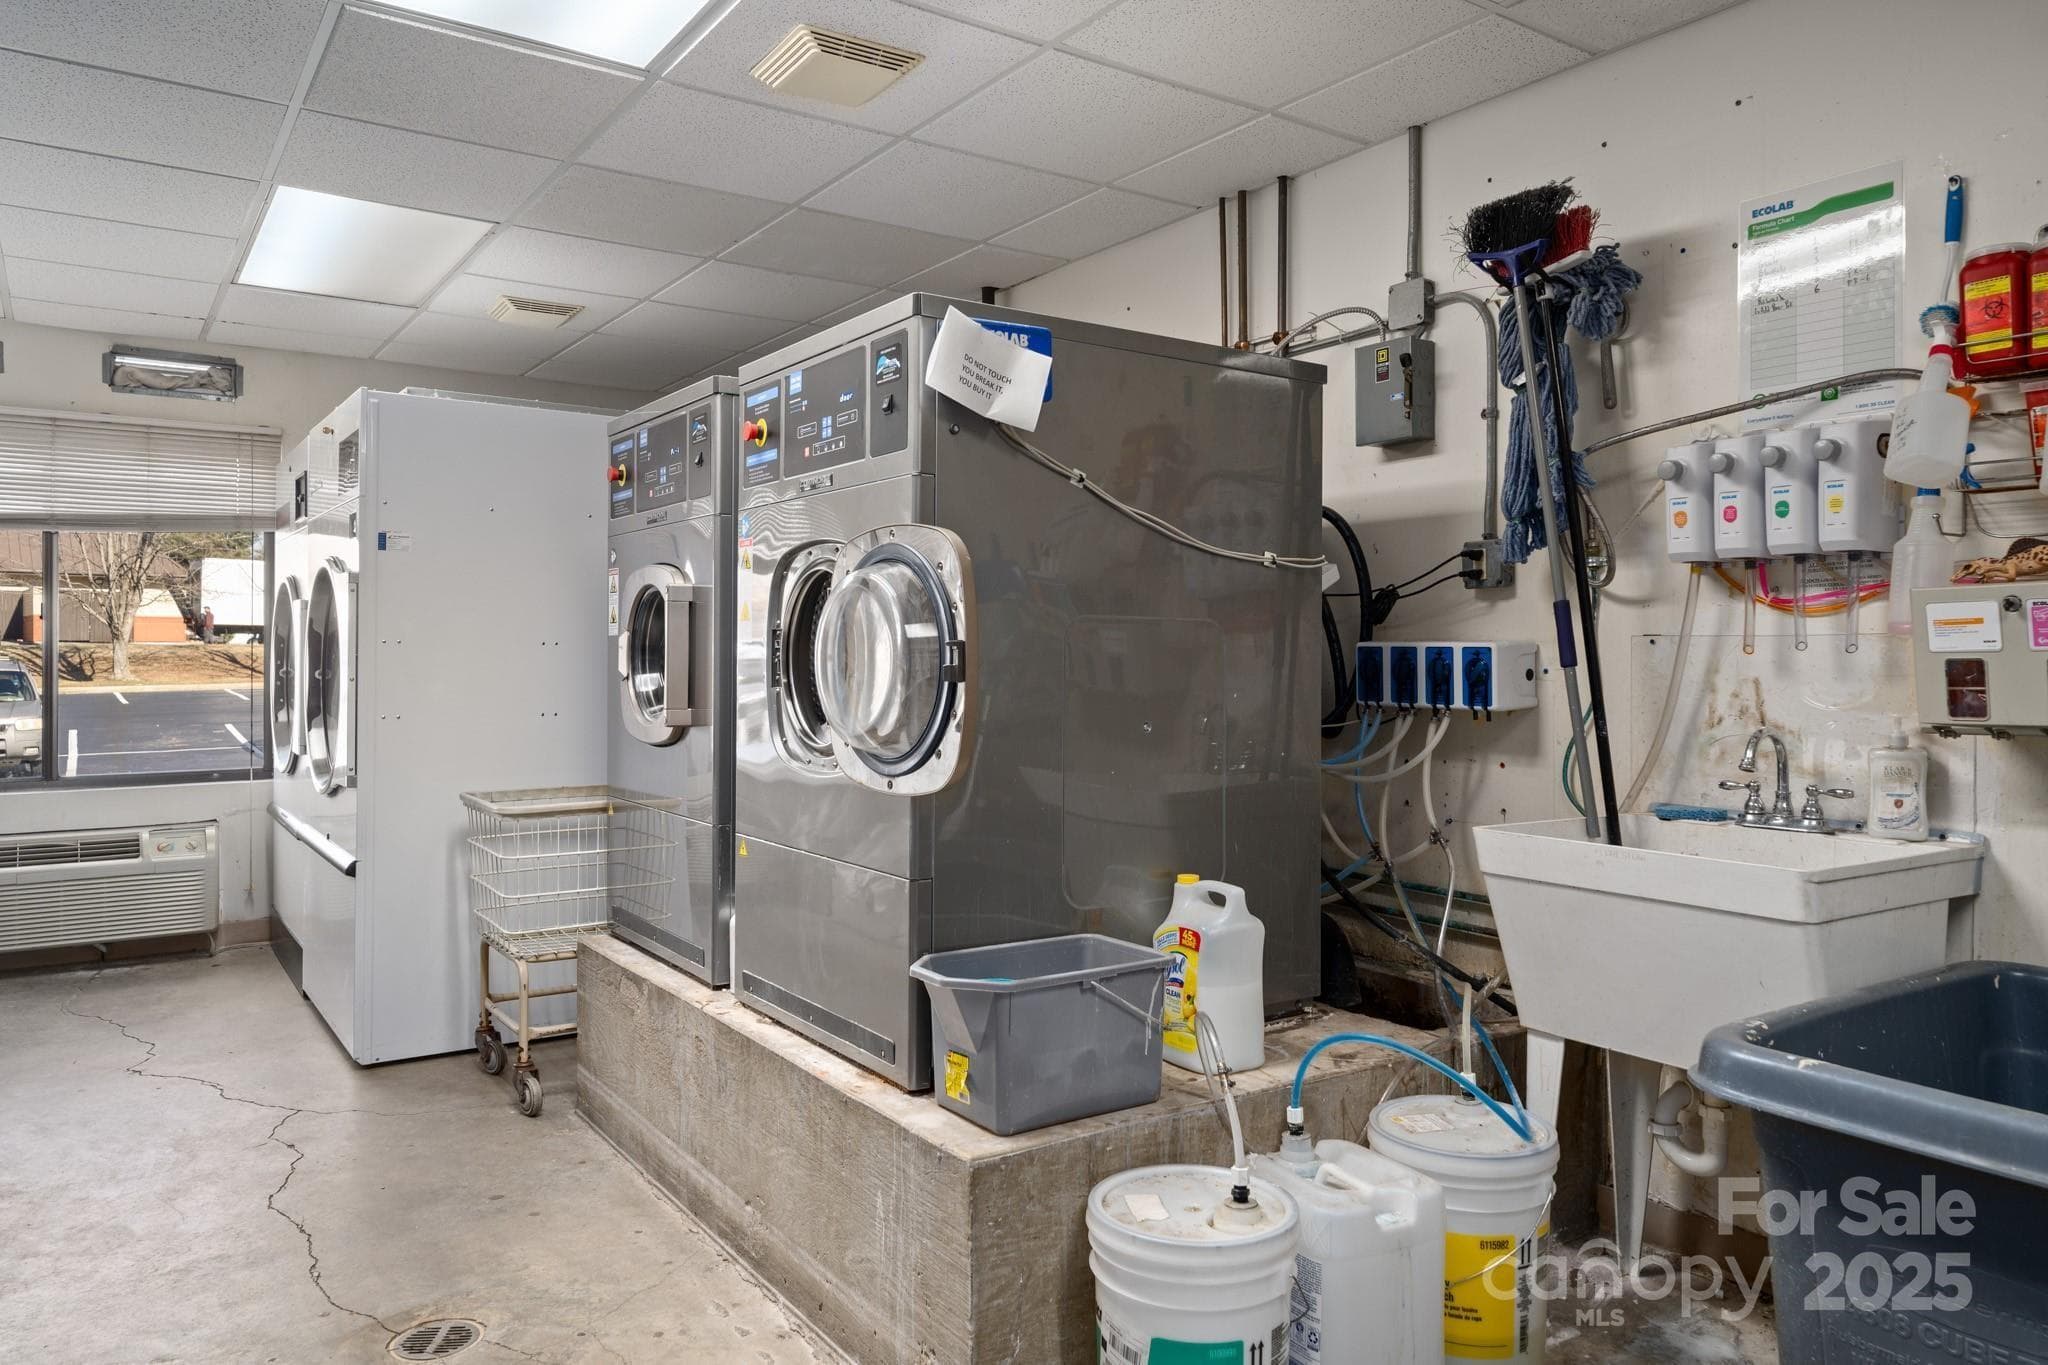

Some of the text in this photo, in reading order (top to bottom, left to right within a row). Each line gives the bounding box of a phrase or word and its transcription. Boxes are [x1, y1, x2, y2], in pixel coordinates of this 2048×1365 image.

[1752, 200, 1794, 219] ECOLAB
[1777, 216, 1795, 225] Chart
[962, 364, 975, 377] YOU
[975, 371, 994, 389] BREAK
[964, 353, 1012, 385] DO NOT TOUCH
[959, 375, 992, 400] YOU BUY IT
